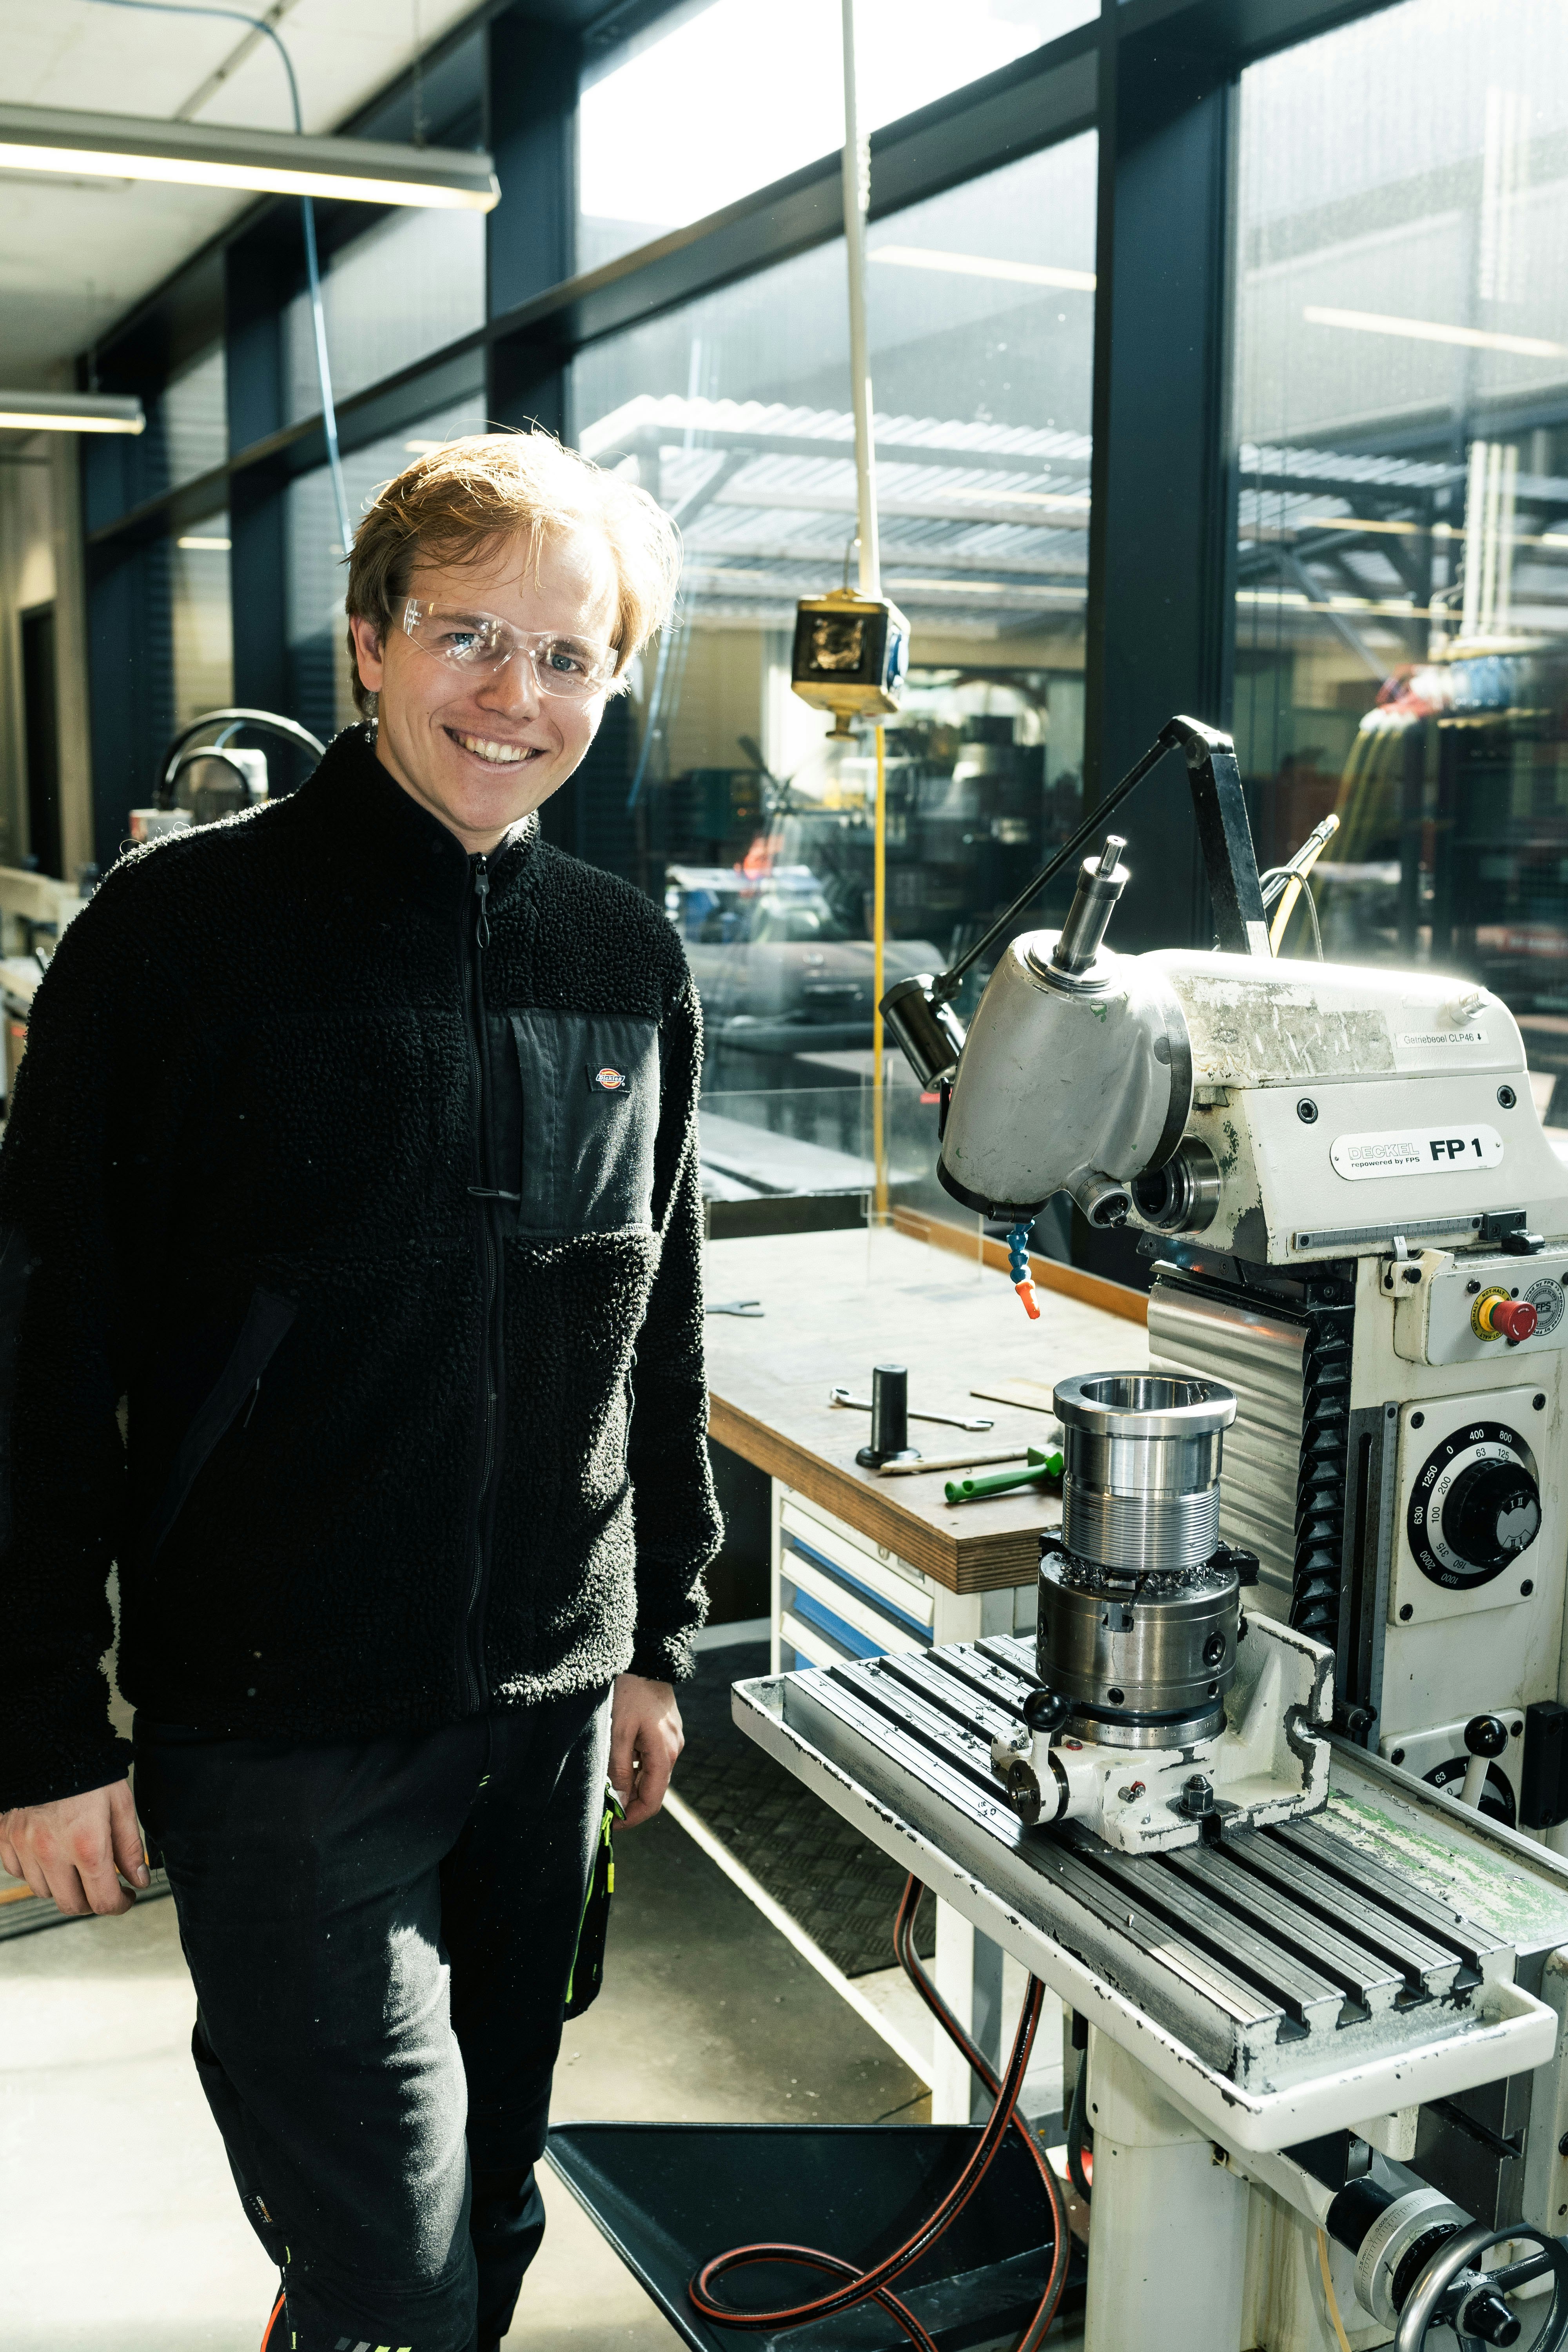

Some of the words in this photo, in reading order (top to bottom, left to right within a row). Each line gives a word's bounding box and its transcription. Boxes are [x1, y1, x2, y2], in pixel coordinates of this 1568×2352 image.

[1404, 1034, 1447, 1044] Getriebeoel
[1449, 1033, 1474, 1042] CLP46
[1348, 1143, 1420, 1160] DECKEL
[1429, 1139, 1465, 1161] FP
[1471, 1138, 1483, 1157] 1
[1351, 1160, 1393, 1168] repowered
[1482, 1288, 1505, 1298] NOT-HALT
[1536, 1301, 1551, 1311] FPS
[1552, 1292, 1563, 1328] repowered
[1470, 1429, 1484, 1440] 400
[1499, 1431, 1512, 1443] 800
[1446, 1446, 1454, 1454] 0
[1476, 1448, 1486, 1457] 63
[1498, 1448, 1510, 1460] 125
[1422, 1465, 1438, 1488] 1250
[1438, 1476, 1451, 1495] 200
[1414, 1506, 1423, 1524] 630
[1431, 1506, 1440, 1523] 100
[1436, 1542, 1449, 1557] 315
[1419, 1550, 1436, 1570] 2000
[1453, 1559, 1466, 1570] 160
[1441, 1573, 1459, 1584] 1000
[1435, 1771, 1446, 1783] 63
[256, 2196, 272, 2223] CORDURA
[1388, 2208, 1398, 2218] mm
[1362, 2248, 1368, 2261] mm
